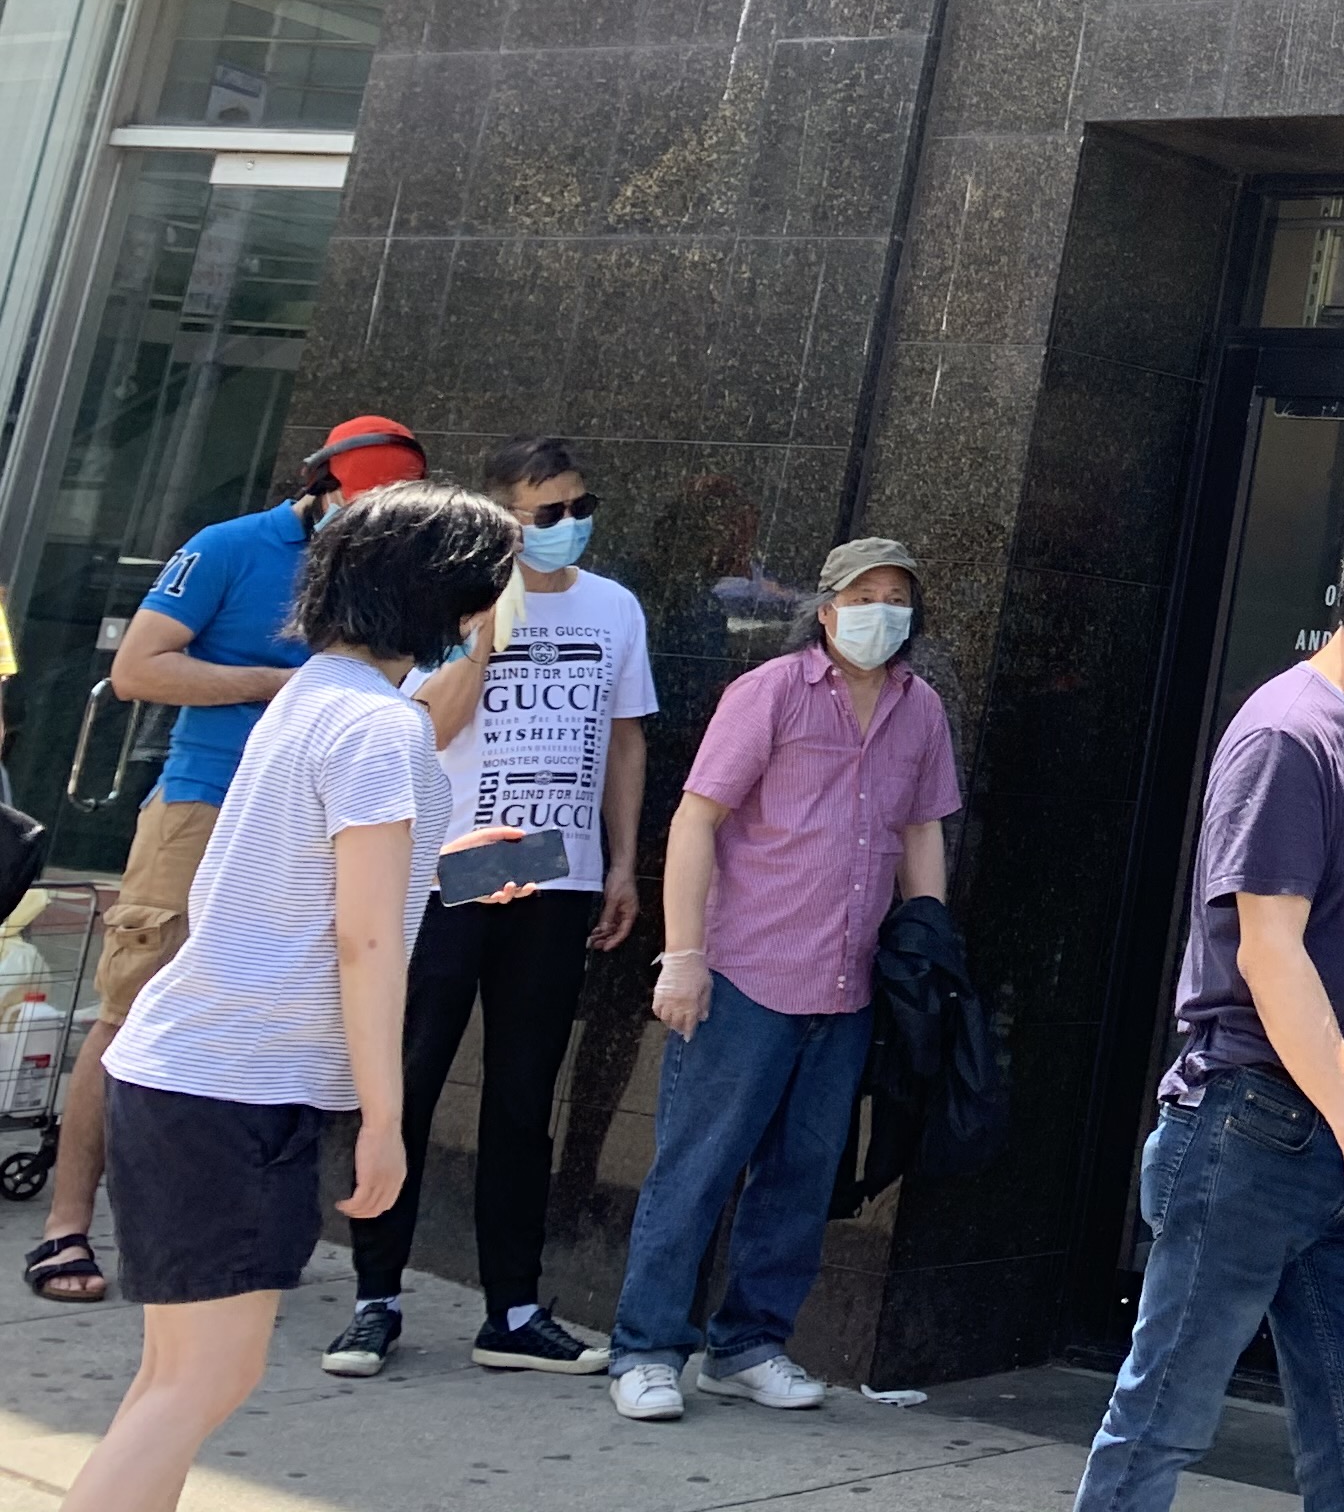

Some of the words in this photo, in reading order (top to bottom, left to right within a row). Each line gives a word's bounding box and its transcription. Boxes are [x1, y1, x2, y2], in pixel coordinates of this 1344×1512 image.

[555, 626, 601, 637] GUCCY
[534, 668, 562, 679] FOR
[568, 667, 604, 679] LOVE
[483, 683, 601, 713] GUCCI
[484, 728, 581, 744] WISHIFY
[483, 756, 539, 768] MONSTER
[474, 771, 500, 828] UCCI
[501, 803, 593, 830] GUCCI
